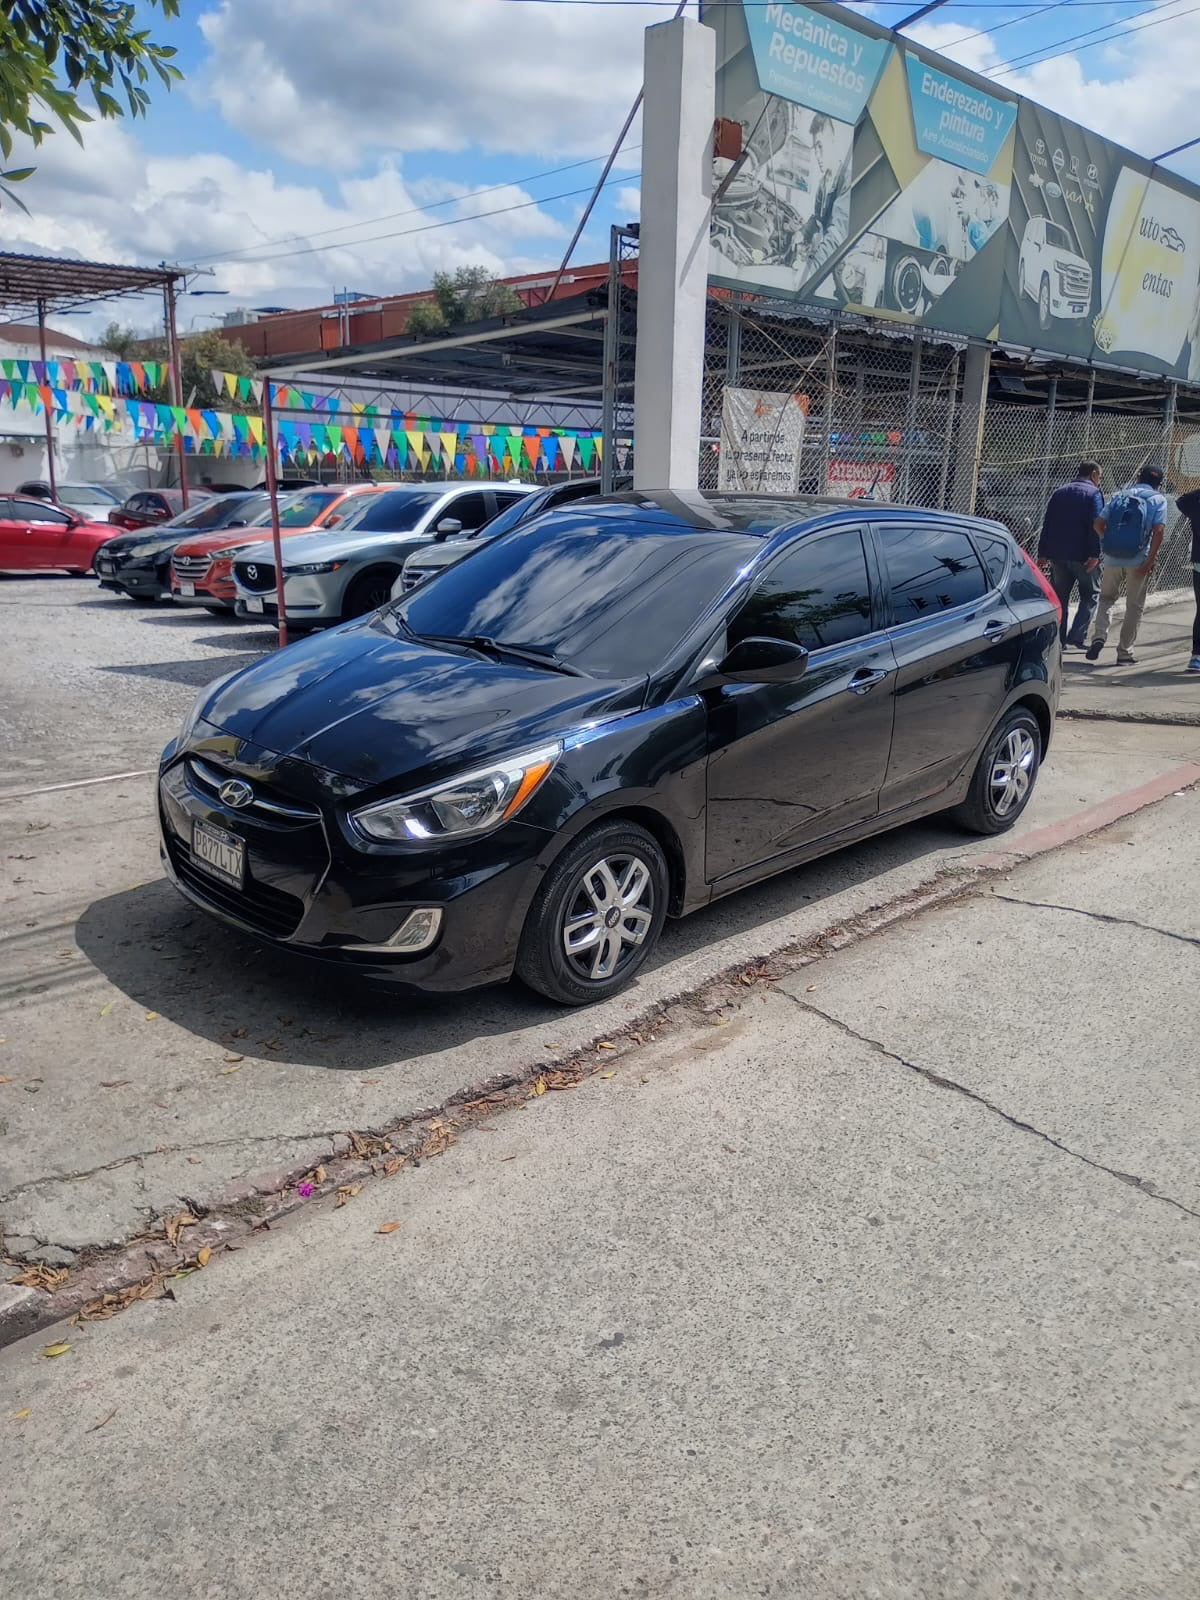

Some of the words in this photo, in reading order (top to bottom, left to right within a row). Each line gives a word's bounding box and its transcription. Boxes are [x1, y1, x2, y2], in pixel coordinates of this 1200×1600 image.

[765, 0, 848, 57] Mecánica
[852, 42, 863, 67] y
[769, 31, 865, 94] Repuestos
[921, 72, 993, 122] Enderezado
[994, 111, 1004, 130] y
[939, 108, 985, 143] pintura
[741, 430, 748, 442] A
[196, 830, 242, 877] P877LTX
